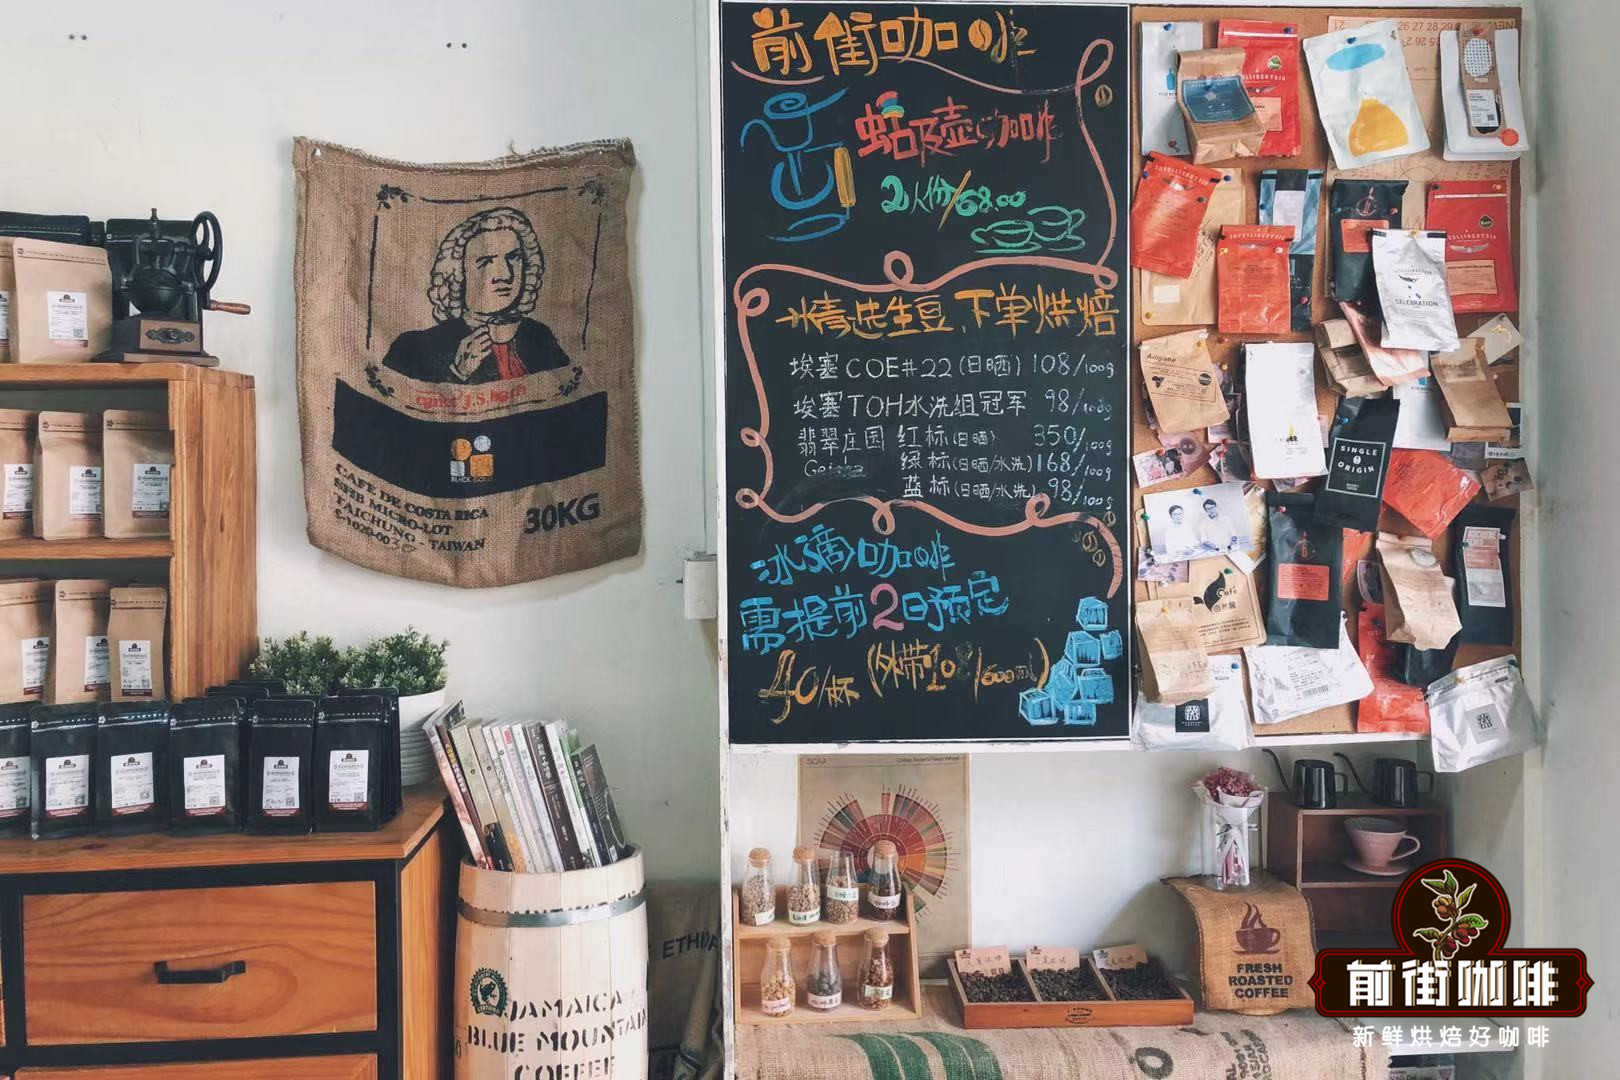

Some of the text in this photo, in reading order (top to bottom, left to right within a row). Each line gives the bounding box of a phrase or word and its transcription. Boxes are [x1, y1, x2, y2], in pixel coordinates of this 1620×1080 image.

[1340, 445, 1378, 456] SINGLE
[1337, 460, 1375, 473] ORIGIN
[336, 463, 377, 496] CAFE
[379, 489, 402, 509] DE
[404, 502, 451, 520] COSTA
[333, 491, 416, 543] TAICHUNG
[428, 537, 486, 552] TAIWAN
[523, 491, 601, 535] 30KG
[750, 523, 956, 586] 冰滴咖啡
[1228, 975, 1294, 987] ROASTED
[1237, 963, 1283, 974] FRESH
[504, 990, 623, 1022] JAMAICA
[1234, 988, 1289, 998] COFFEE
[468, 1024, 525, 1053] BLUE
